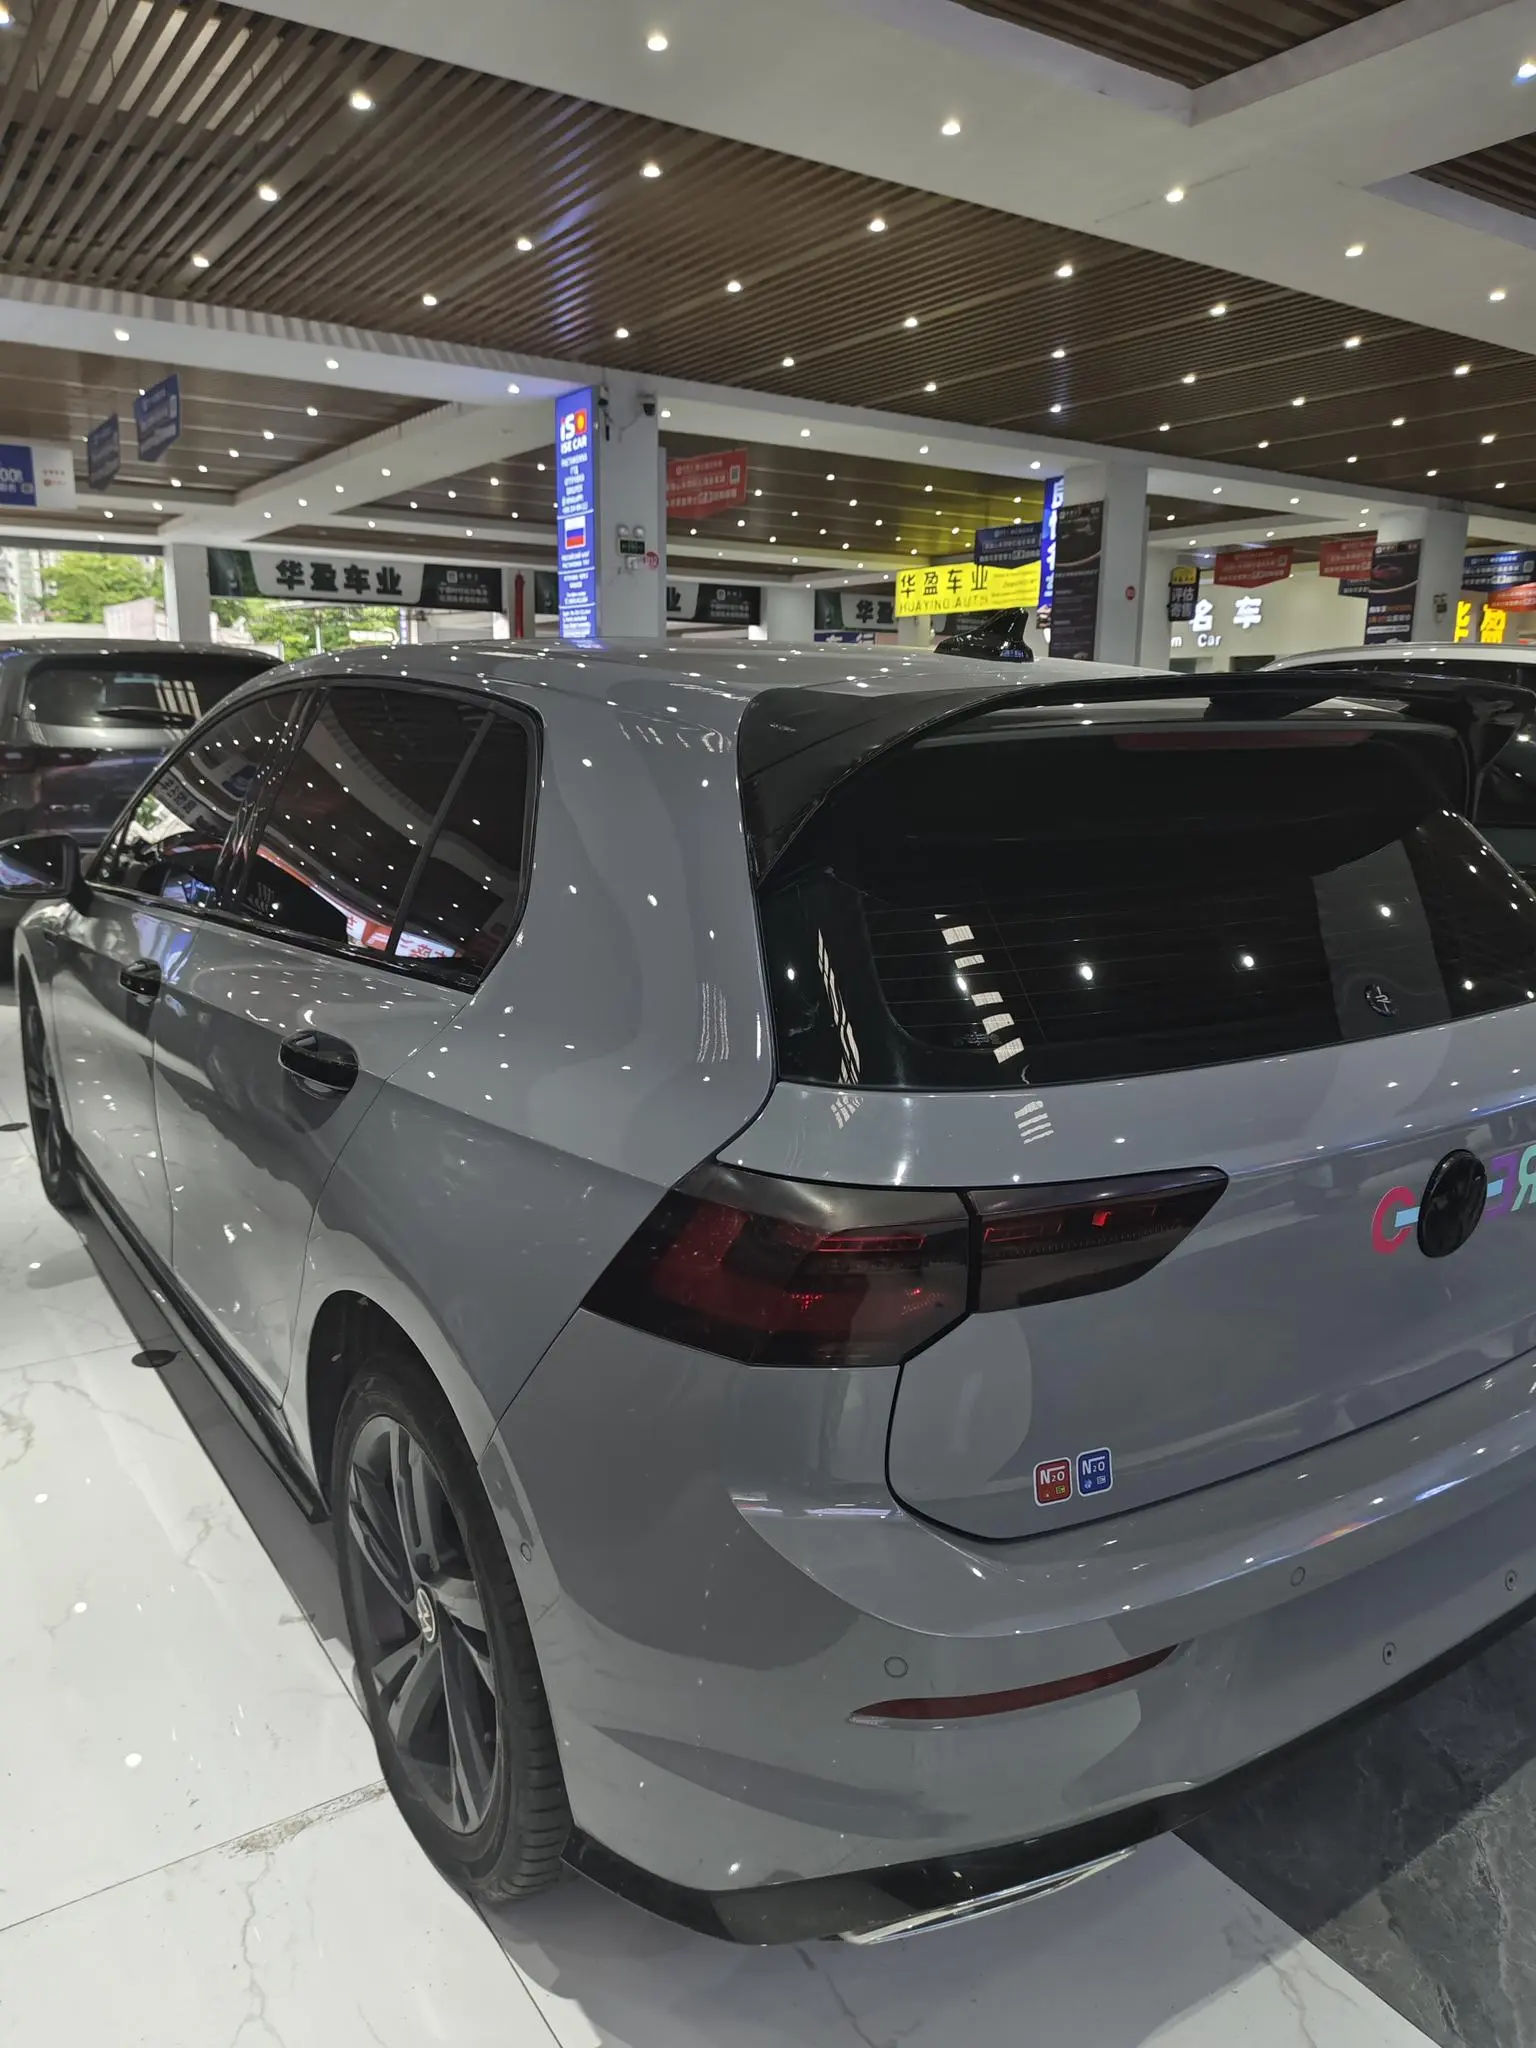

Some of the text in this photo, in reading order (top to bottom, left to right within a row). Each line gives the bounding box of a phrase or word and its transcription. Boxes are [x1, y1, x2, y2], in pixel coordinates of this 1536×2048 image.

[275, 559, 402, 596] 华盈车业
[900, 564, 988, 599] 华盈车业
[1197, 633, 1222, 648] Car
